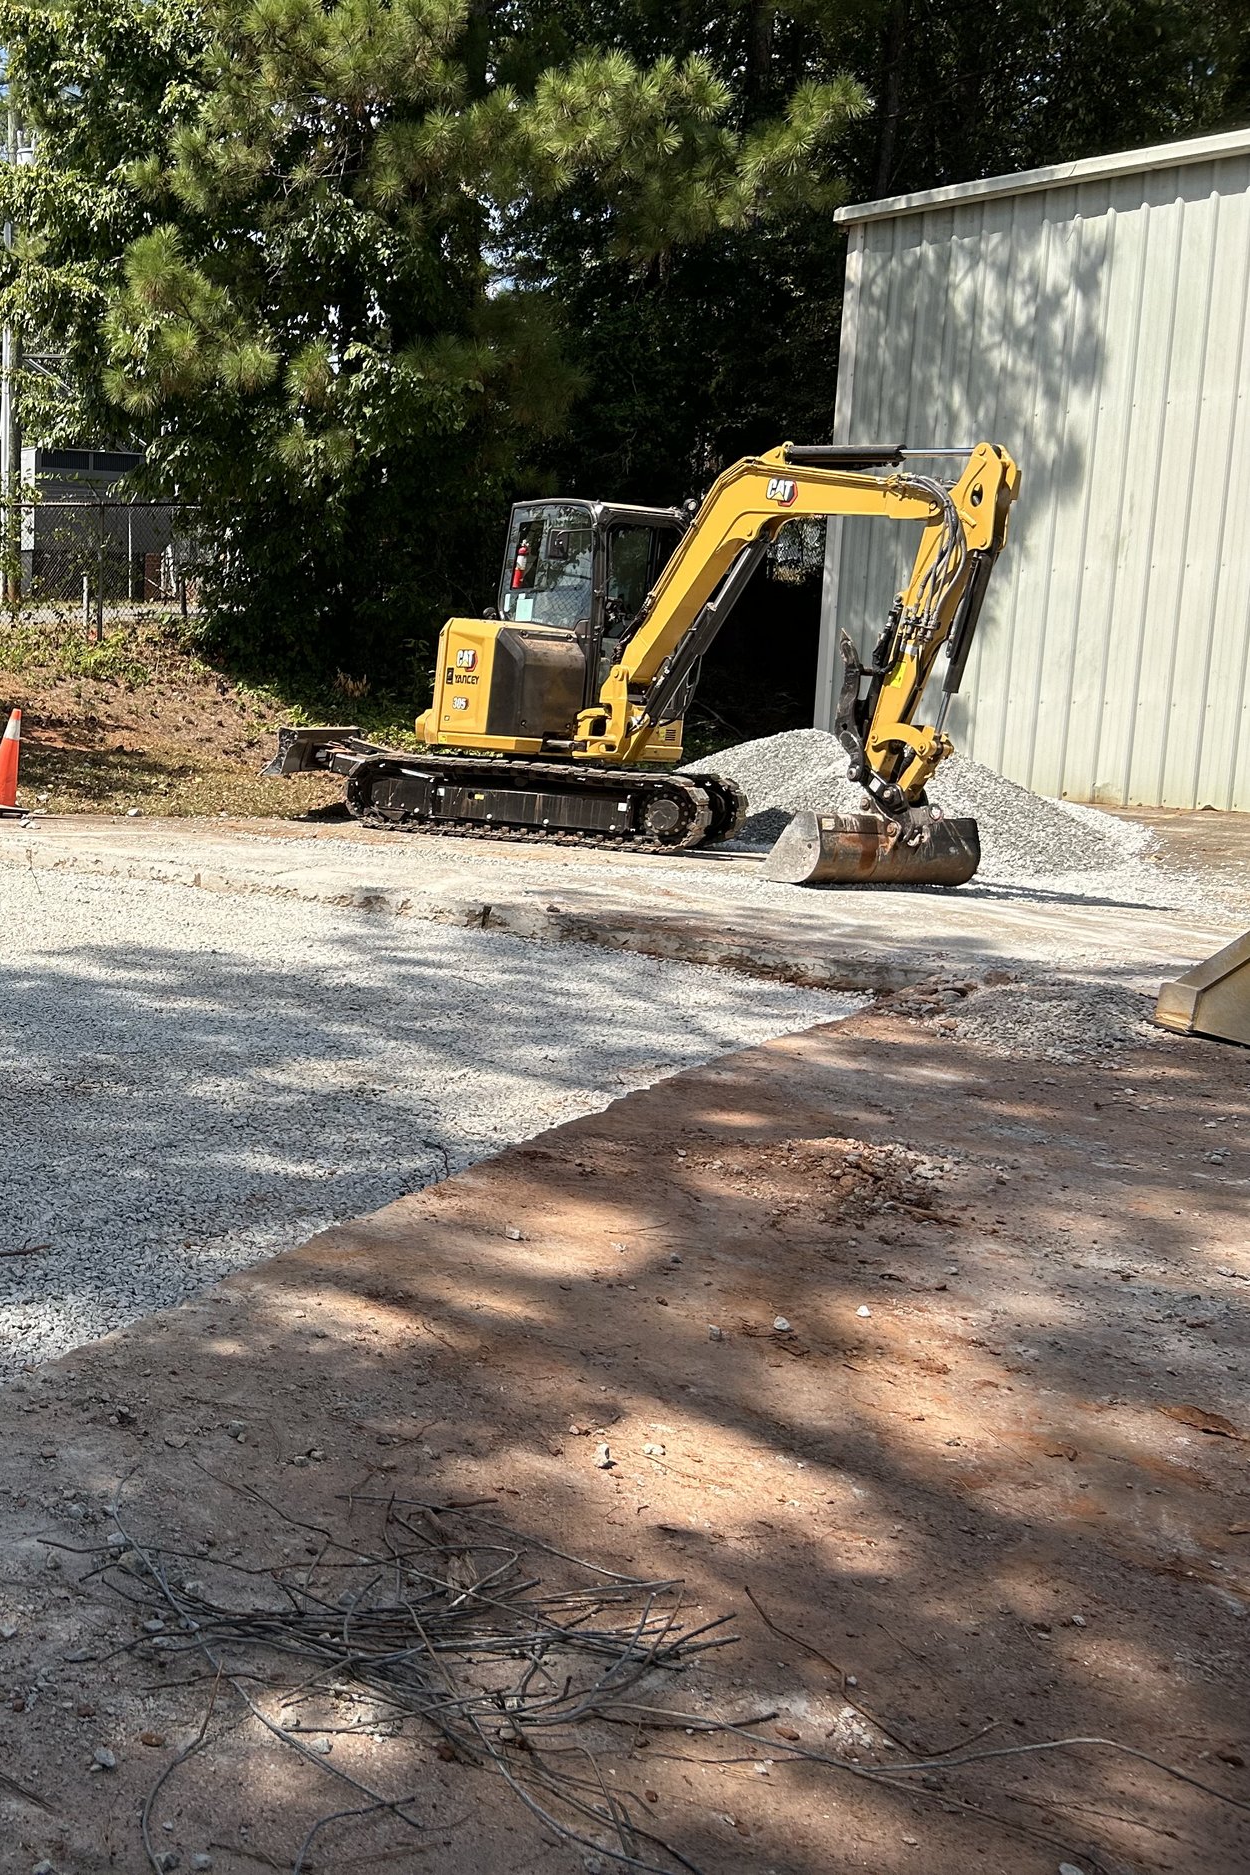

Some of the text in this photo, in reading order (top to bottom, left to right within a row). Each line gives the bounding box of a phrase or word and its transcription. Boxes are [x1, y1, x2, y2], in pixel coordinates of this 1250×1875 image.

[766, 478, 795, 501] CAT
[456, 649, 476, 668] CAT
[455, 674, 479, 685] YANCEY
